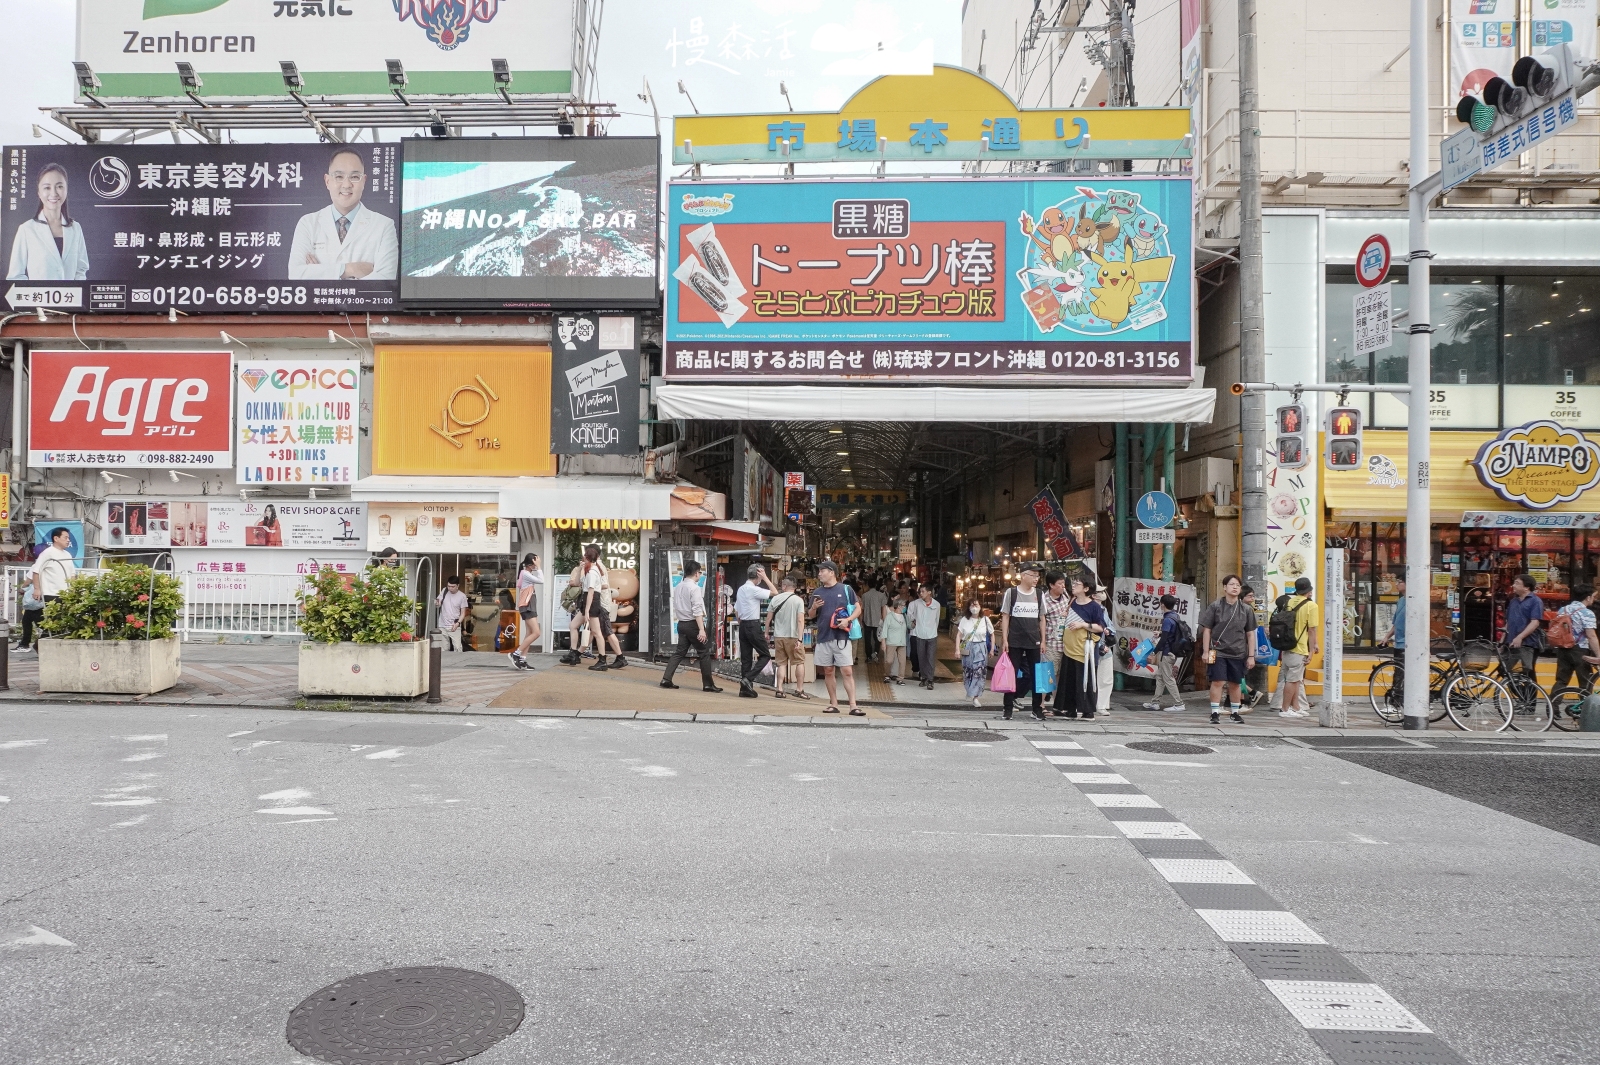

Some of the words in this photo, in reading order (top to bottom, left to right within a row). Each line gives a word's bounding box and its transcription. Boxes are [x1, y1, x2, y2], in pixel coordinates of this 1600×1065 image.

[123, 31, 256, 53] Zenhoren
[767, 117, 1089, 153] 市場本通り
[1483, 97, 1574, 167] 時差式信号機
[137, 162, 304, 190] 東京美容外科
[170, 197, 232, 216] 沖縄院
[592, 214, 637, 229] BAR
[838, 204, 904, 234] 黒糖
[113, 232, 282, 248] 豊胸・鼻形成・目元形成
[136, 254, 265, 270] アンチエイジング
[752, 238, 996, 286] ドーナツ棒
[152, 286, 308, 305] 0120-658-958
[314, 288, 356, 296] 電話受付時間
[752, 289, 996, 317] そらとぶピカチュウ版
[676, 350, 864, 369] 商品に関するお問合せ
[1052, 352, 1180, 369] 0120-81-3156
[270, 368, 358, 398] epica
[50, 366, 209, 436] Agre
[1556, 392, 1576, 404] 35
[246, 402, 294, 420] OKINAWA
[298, 402, 320, 420] No.1
[324, 402, 350, 420] CLUB
[430, 374, 499, 448] KOI
[144, 425, 196, 436] アグレ
[242, 425, 354, 444] 女性入場無料
[476, 436, 500, 450] Thé
[66, 454, 126, 464] 求人おきなわ
[148, 454, 214, 464] 098-882-2490
[1491, 442, 1590, 476] NAMPO
[245, 466, 302, 482] LADIES
[312, 466, 349, 482] FREE
[1506, 478, 1520, 486] THE
[280, 506, 300, 515] REVI
[196, 562, 246, 572] 広告募集
[607, 556, 636, 568] Thé
